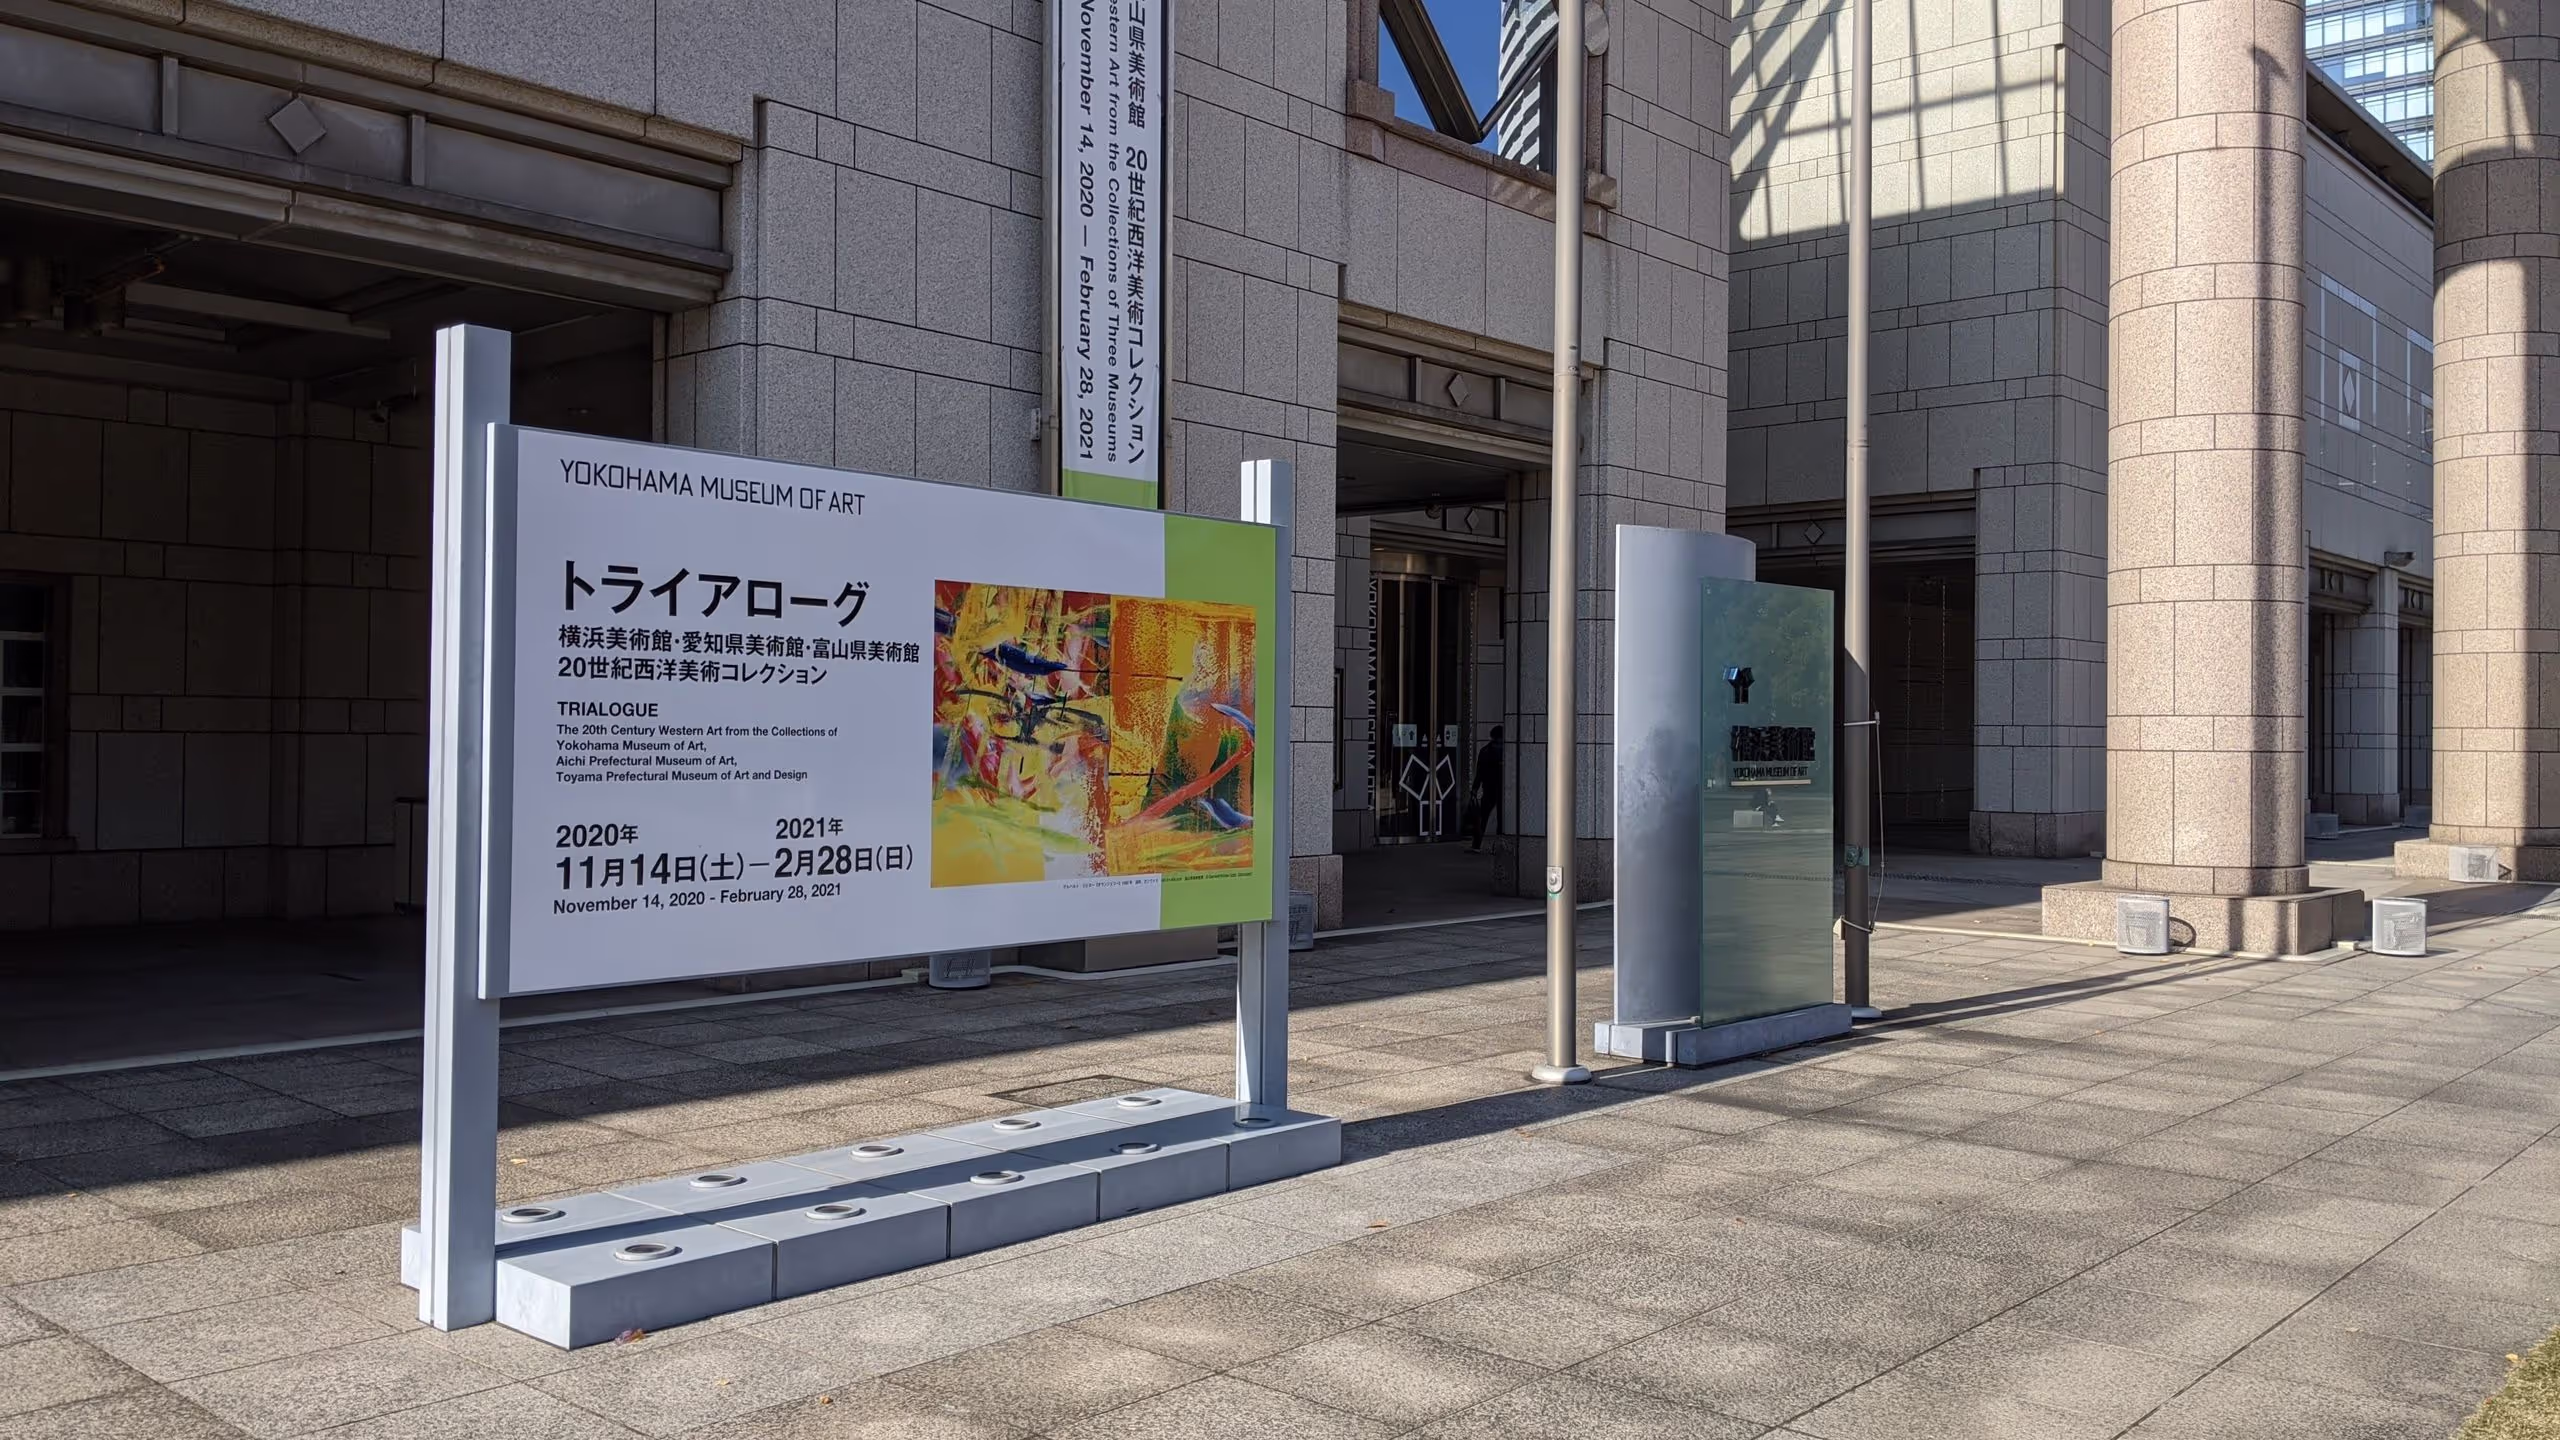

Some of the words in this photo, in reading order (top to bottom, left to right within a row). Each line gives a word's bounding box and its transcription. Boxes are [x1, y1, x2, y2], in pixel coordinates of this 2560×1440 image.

[1080, 0, 1095, 116] November
[1109, 57, 1120, 87] Art
[1126, 0, 1148, 131] 山県美術館
[1109, 92, 1120, 136] from
[1077, 123, 1094, 153] 14,
[1108, 142, 1120, 172] the
[1079, 160, 1094, 218] 2020
[1108, 178, 1120, 284] Collections
[1076, 255, 1094, 361] February
[1108, 289, 1120, 310] of
[1125, 146, 1148, 464] 20世紀西洋美術コレクション
[1108, 314, 1120, 367] Three
[1077, 365, 1094, 399] 28,
[1079, 407, 1094, 459] 2021
[1107, 373, 1120, 462] Museums
[559, 458, 694, 497] YOKOHAMA
[700, 474, 793, 509] MUSEUM
[799, 487, 827, 511] OF
[828, 490, 866, 516] ART
[564, 560, 870, 628] トライアローグ
[557, 655, 828, 686] 20世紀西洋美術コレクション
[556, 700, 659, 718] TRIALOGUE
[555, 723, 580, 736] The
[581, 723, 608, 736] 20th
[610, 723, 656, 738] Century
[657, 724, 704, 736] Western
[705, 725, 723, 737] Art
[724, 725, 750, 737] from
[751, 725, 769, 737] the
[770, 725, 826, 737] Collections
[827, 726, 838, 737] of
[555, 739, 620, 751] Yokohama
[622, 739, 671, 751] Museum
[673, 739, 686, 751] of
[686, 740, 707, 753] Art,
[555, 755, 586, 767] Aichi
[588, 754, 653, 767] Prefectural
[655, 755, 703, 767] Museum
[704, 754, 717, 766] of
[718, 755, 738, 768] Art,
[555, 771, 604, 785] Toyama
[605, 770, 669, 782] Prefectural
[671, 770, 718, 782] Museum
[720, 769, 732, 781] of
[733, 769, 750, 781] Art
[751, 769, 772, 781] and
[773, 769, 808, 782] Design
[555, 822, 639, 849] 2020年
[775, 816, 844, 840] 2021年
[553, 895, 638, 915] November
[642, 893, 665, 911] 14,
[668, 890, 706, 907] 2020
[720, 888, 785, 904] February
[787, 884, 808, 901] 28,
[810, 882, 841, 898] 2021
